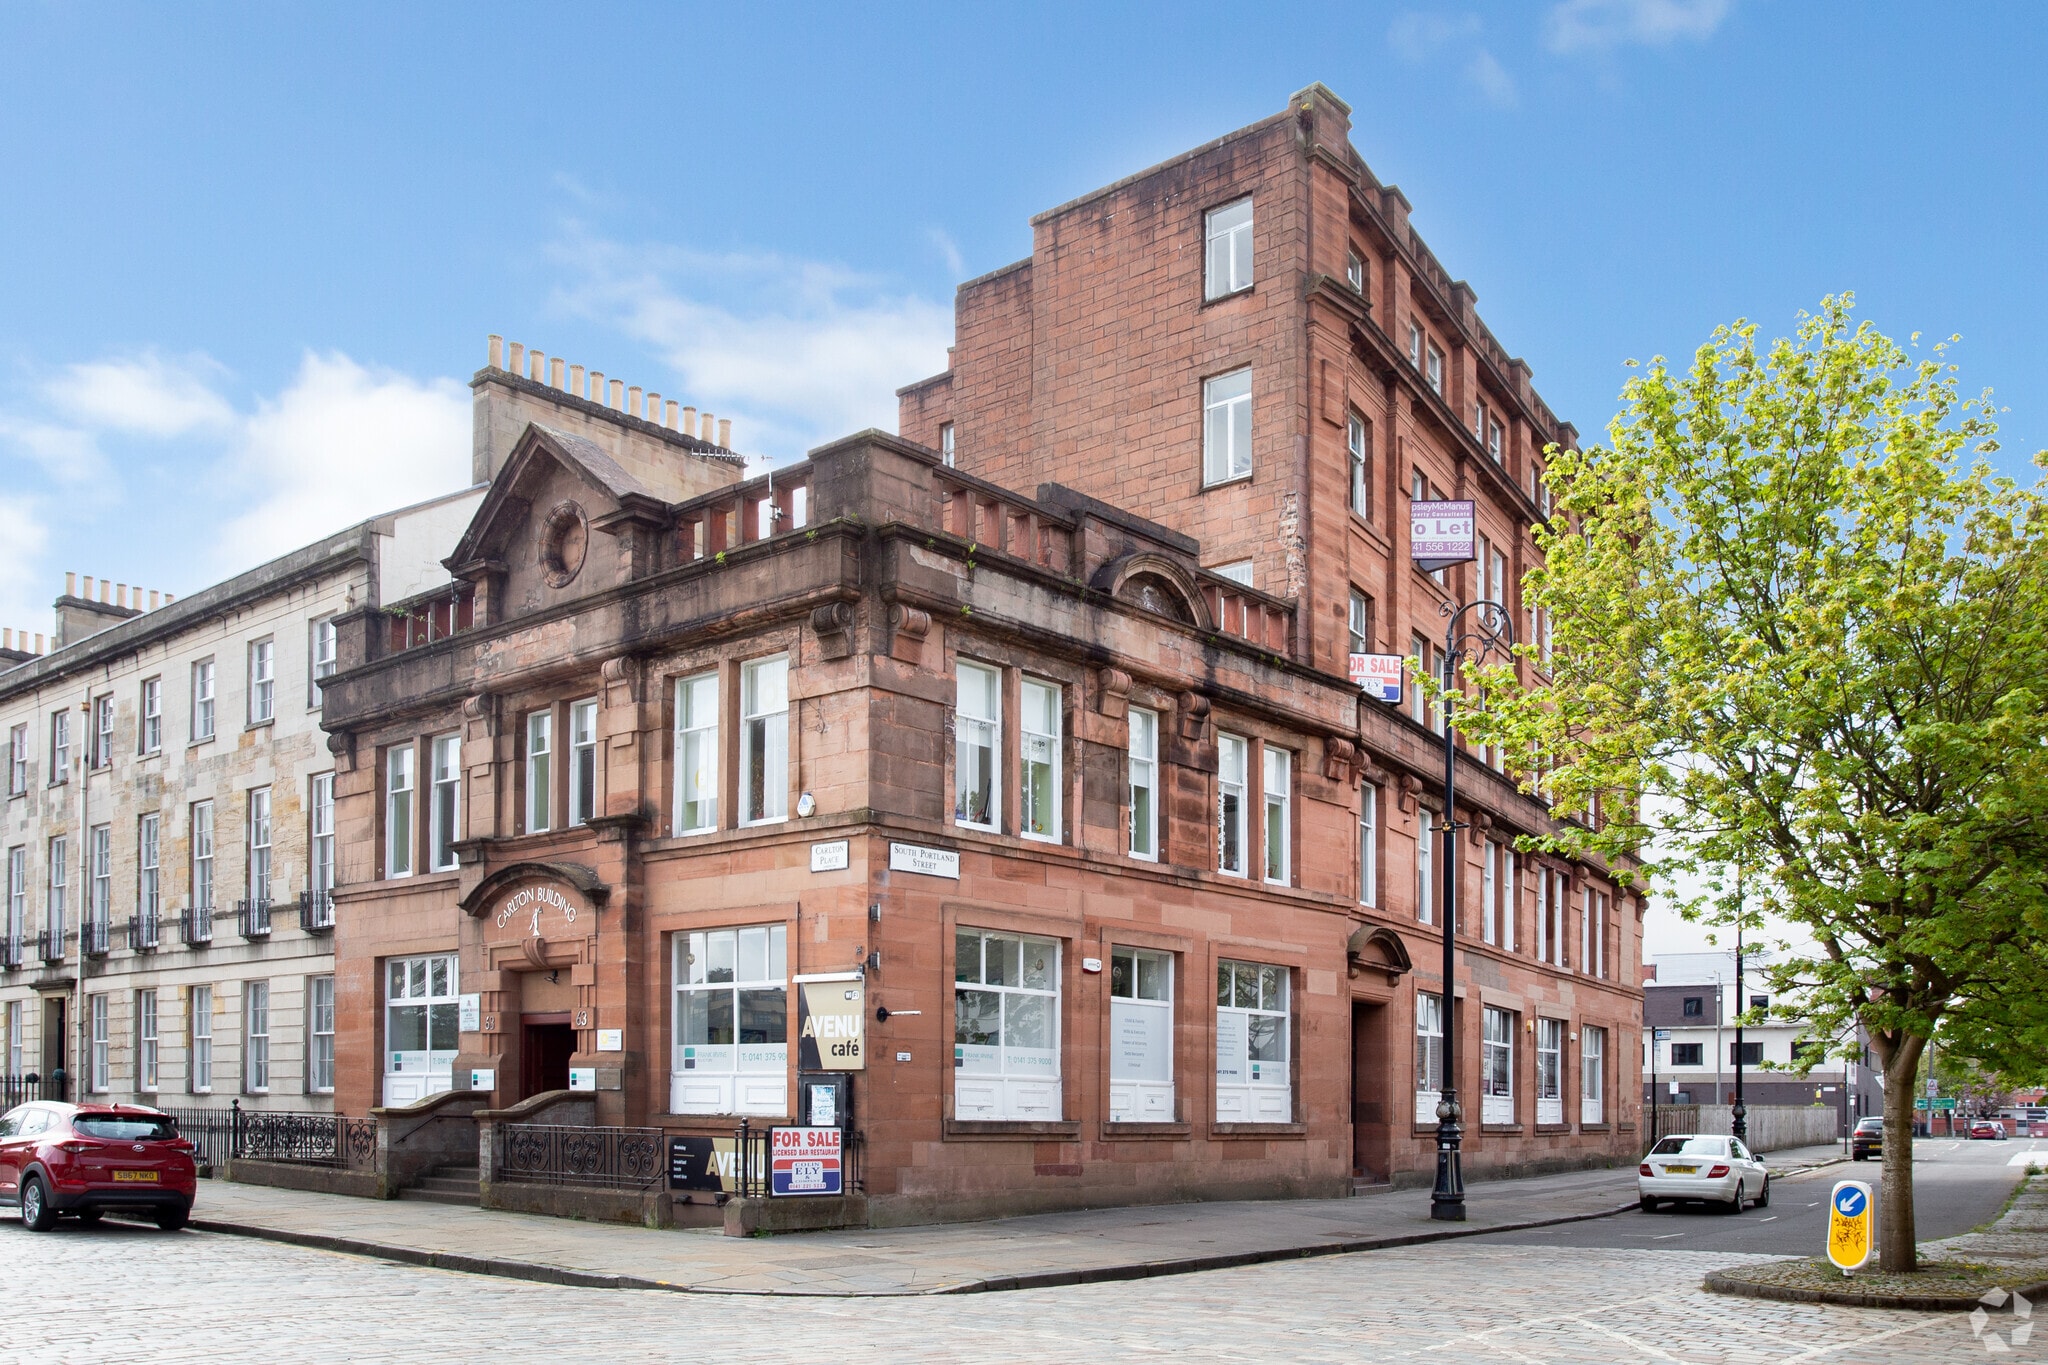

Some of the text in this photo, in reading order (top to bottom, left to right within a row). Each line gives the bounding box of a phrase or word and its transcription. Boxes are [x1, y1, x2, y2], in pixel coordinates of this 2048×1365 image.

[1436, 520, 1471, 535] Let
[1425, 542, 1444, 551] 556
[1447, 542, 1470, 551] 1222
[1370, 657, 1400, 674] SALE
[815, 845, 844, 855] CARLTON
[894, 845, 955, 863] SOUTH PORTLAND
[819, 855, 839, 864] PLACE
[912, 858, 937, 870] STREET
[497, 887, 577, 929] CARLTON BUILDING
[485, 1015, 495, 1030] 63
[576, 1010, 588, 1026] 63
[801, 1015, 860, 1038] AVENU
[831, 1038, 859, 1056] café
[749, 1053, 763, 1062] 0141
[765, 1053, 776, 1061] 375
[1014, 1056, 1026, 1064] 0141
[1027, 1057, 1037, 1065] 375
[1039, 1058, 1052, 1066] 9000
[773, 1131, 840, 1148] FOR SALE
[810, 1148, 840, 1156] RESTAURANT
[795, 1167, 820, 1175] ELY
